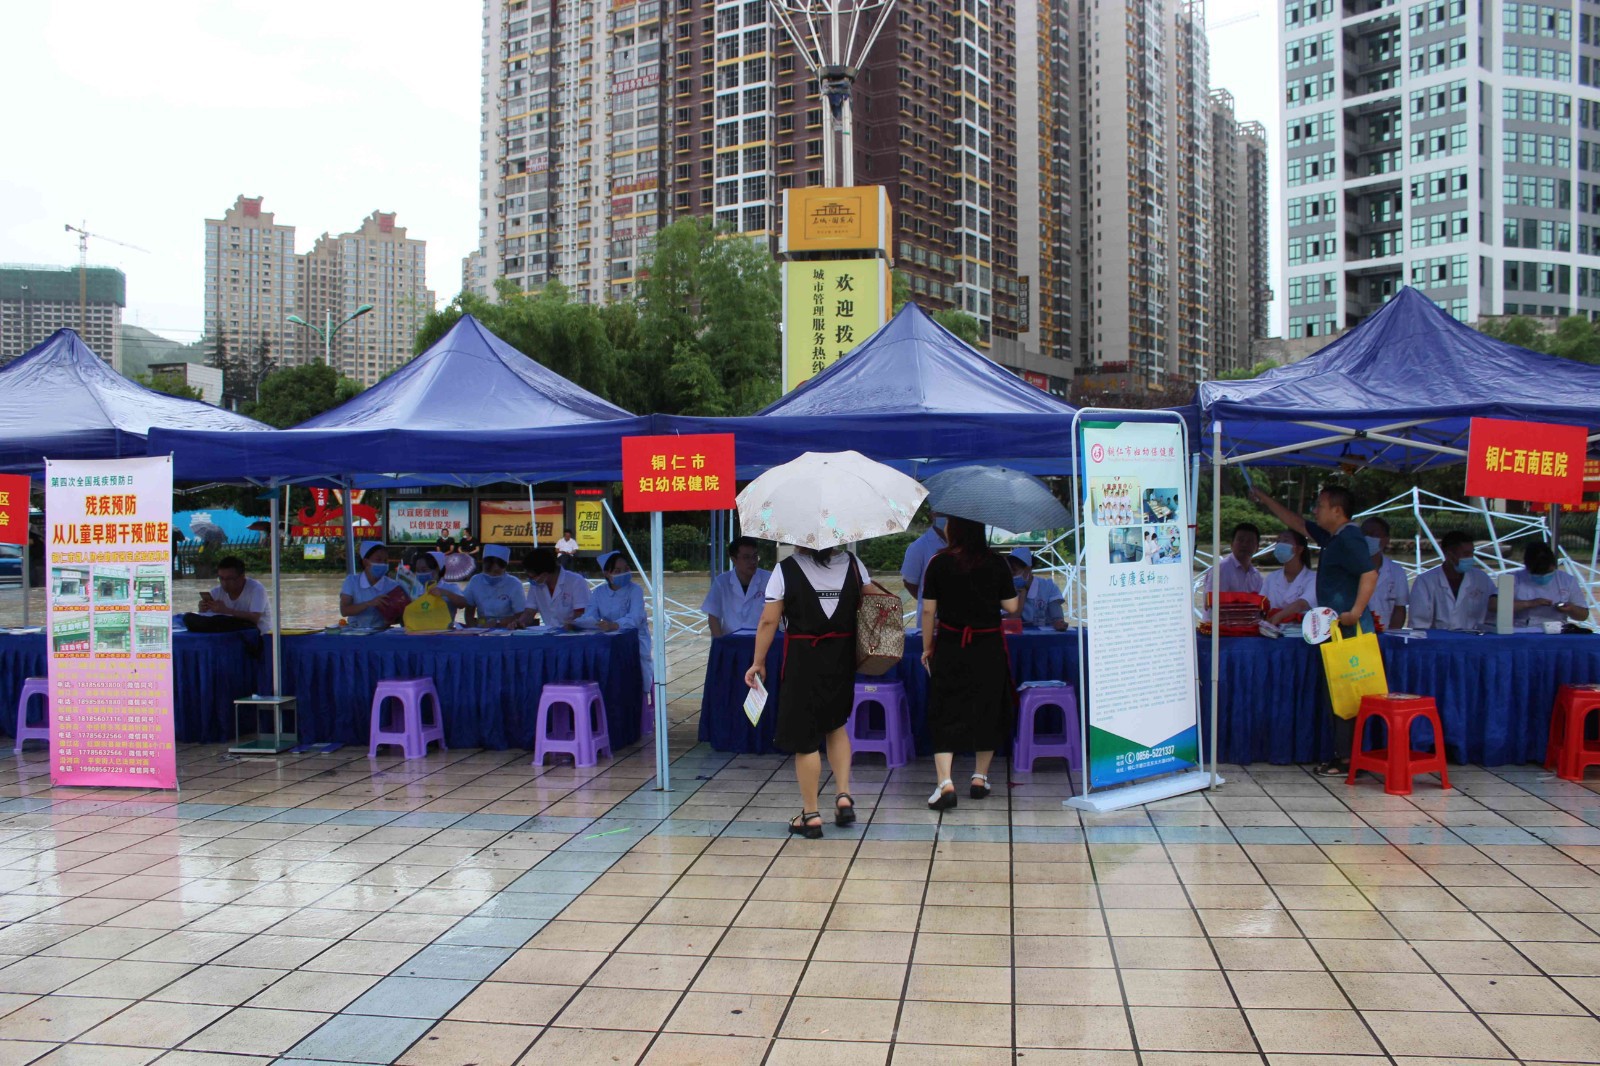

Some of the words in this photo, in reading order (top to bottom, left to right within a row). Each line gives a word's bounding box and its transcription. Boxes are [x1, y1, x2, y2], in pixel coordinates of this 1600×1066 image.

[812, 269, 826, 373] 城市管理服务热线
[1107, 446, 1175, 457] 铜仁市妇幼保健院
[651, 454, 706, 470] 铜仁市
[1486, 446, 1568, 477] 铜仁西南医院
[51, 476, 133, 487] 第四次全国残疾预防日
[639, 475, 719, 492] 妇幼保健院
[86, 495, 137, 516] 残疾预防
[398, 508, 449, 517] 以宜居促创业
[578, 511, 600, 520] 广告位
[53, 522, 169, 545] 从儿童早期干预做起
[409, 521, 461, 530] 以创业促发展
[491, 521, 554, 537] 广告位招租
[579, 520, 598, 531] 招租
